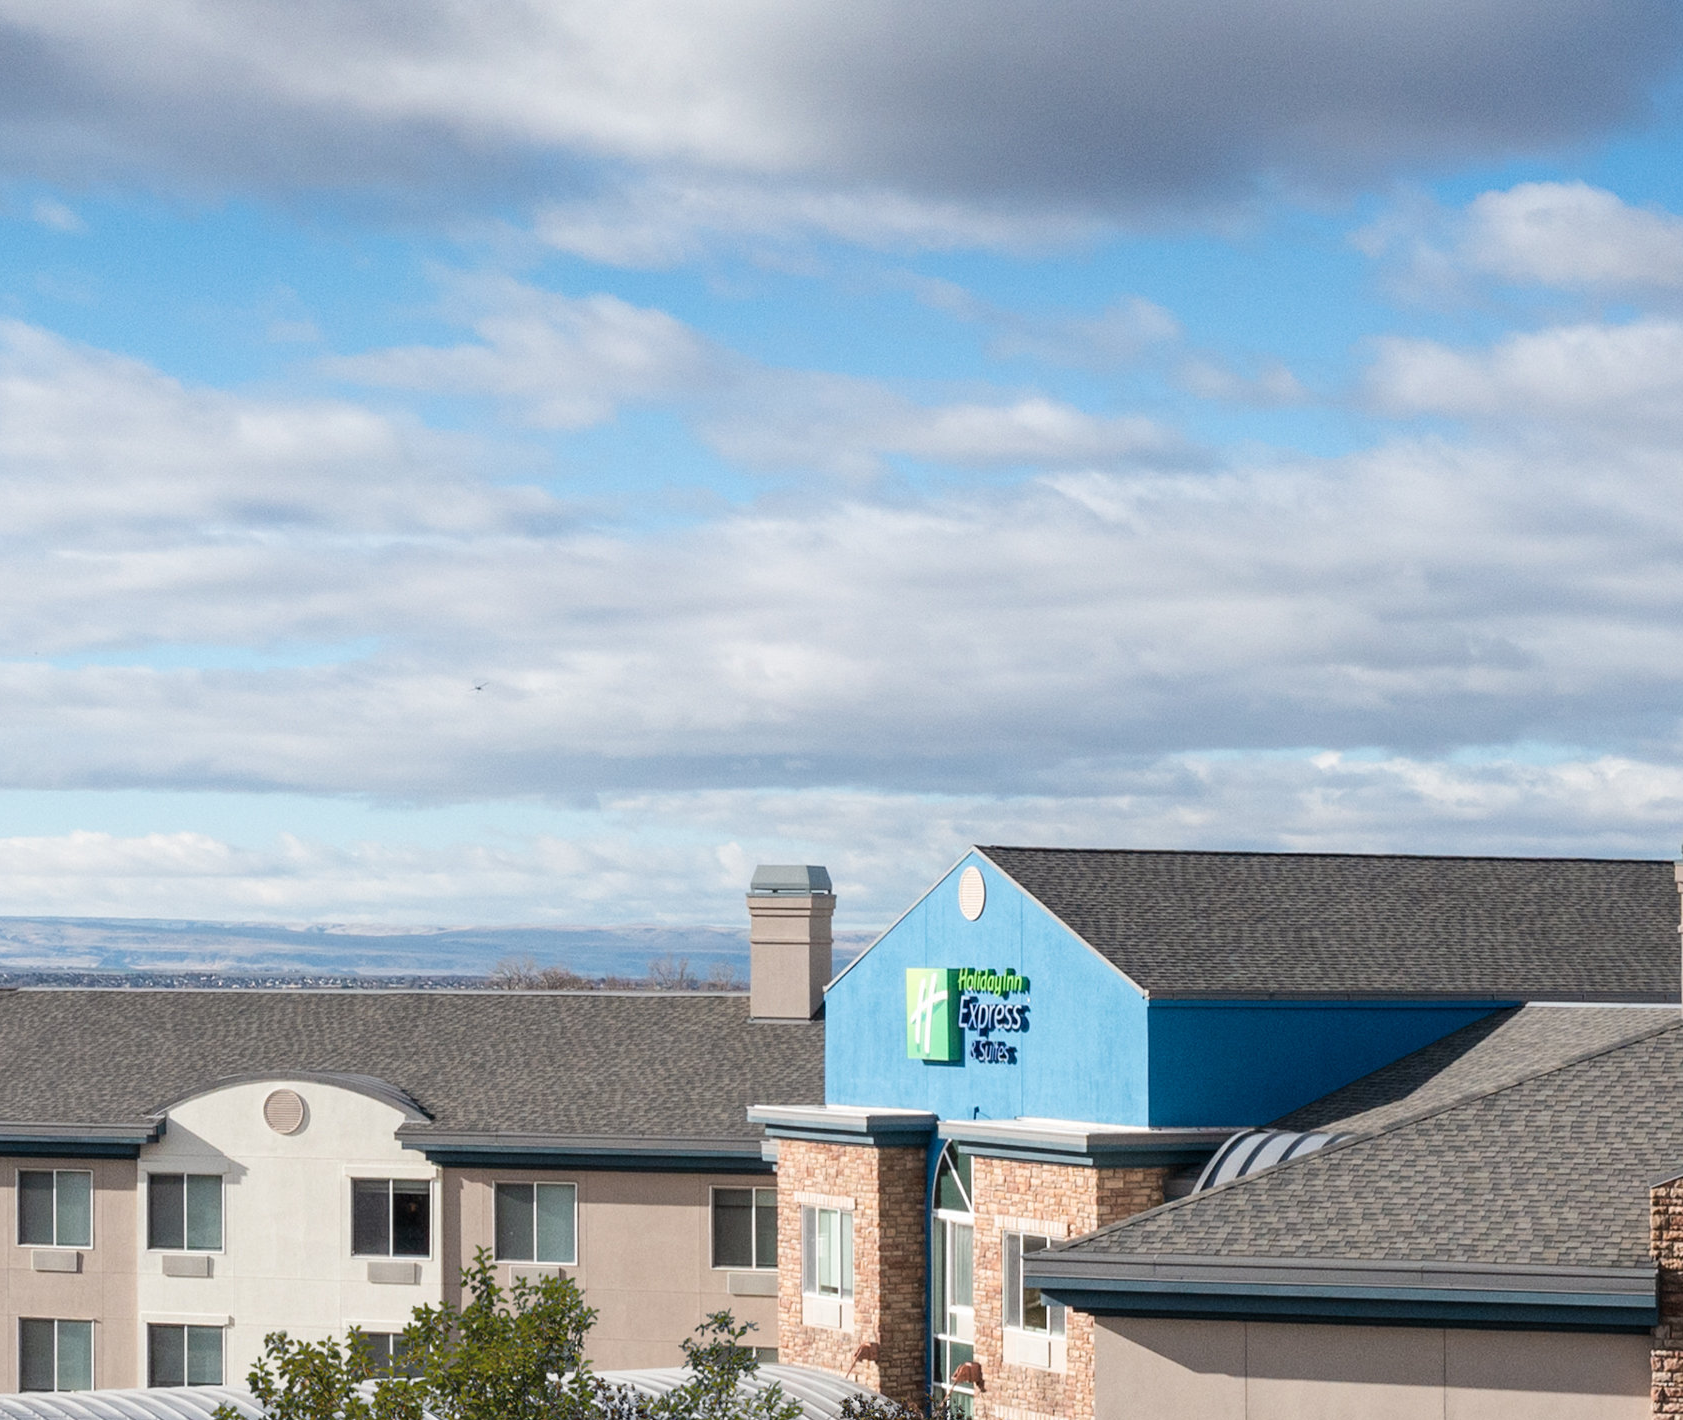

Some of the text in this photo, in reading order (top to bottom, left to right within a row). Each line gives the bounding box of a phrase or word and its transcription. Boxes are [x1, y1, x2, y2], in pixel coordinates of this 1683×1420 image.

[958, 968, 1022, 997] Holiday Inn
[958, 995, 1022, 1037] Express
[979, 1040, 1009, 1062] Suites
